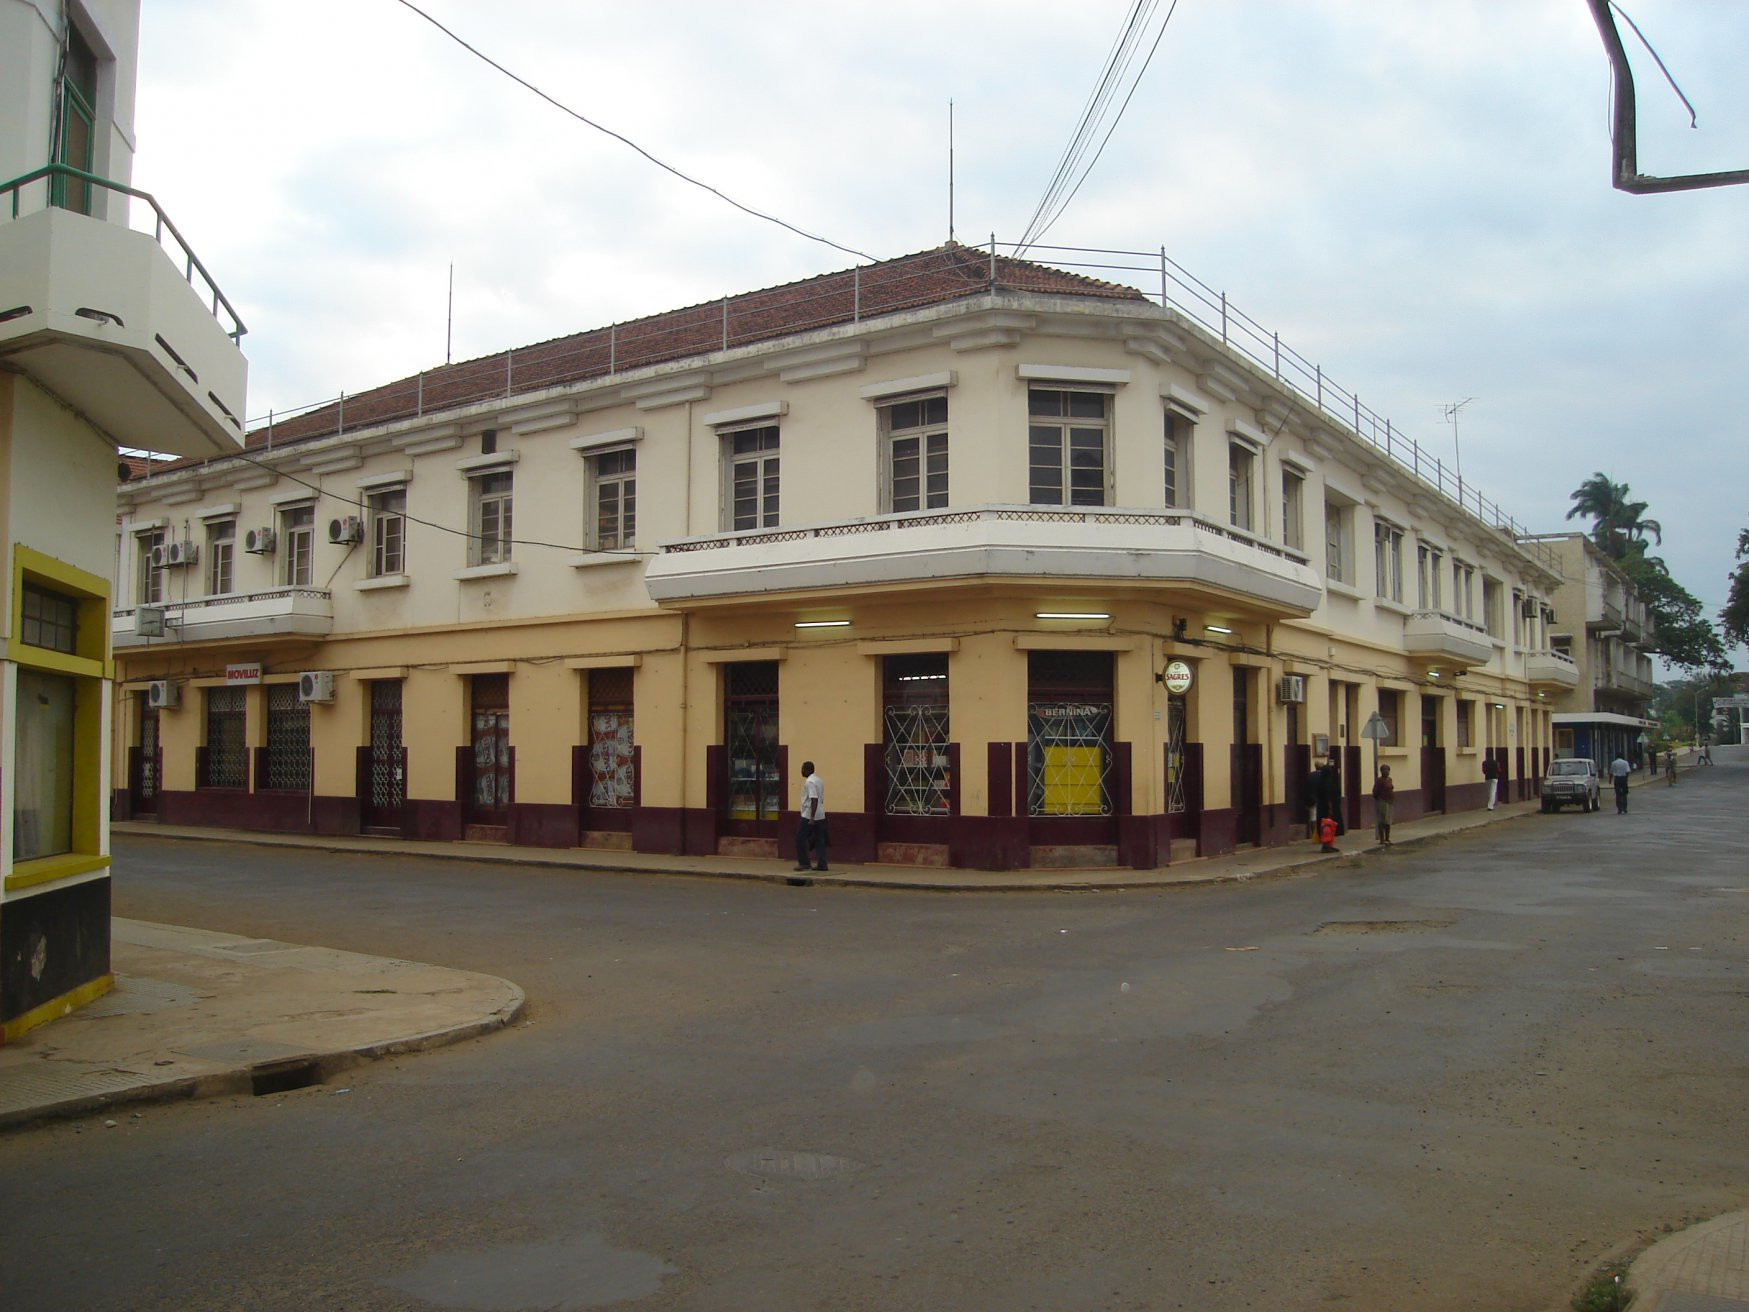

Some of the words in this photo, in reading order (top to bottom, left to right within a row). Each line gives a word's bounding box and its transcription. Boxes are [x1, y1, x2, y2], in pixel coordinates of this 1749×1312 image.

[227, 669, 259, 679] MOVILUZ
[1166, 673, 1189, 681] SAGRES
[1045, 706, 1091, 716] BERNINA
